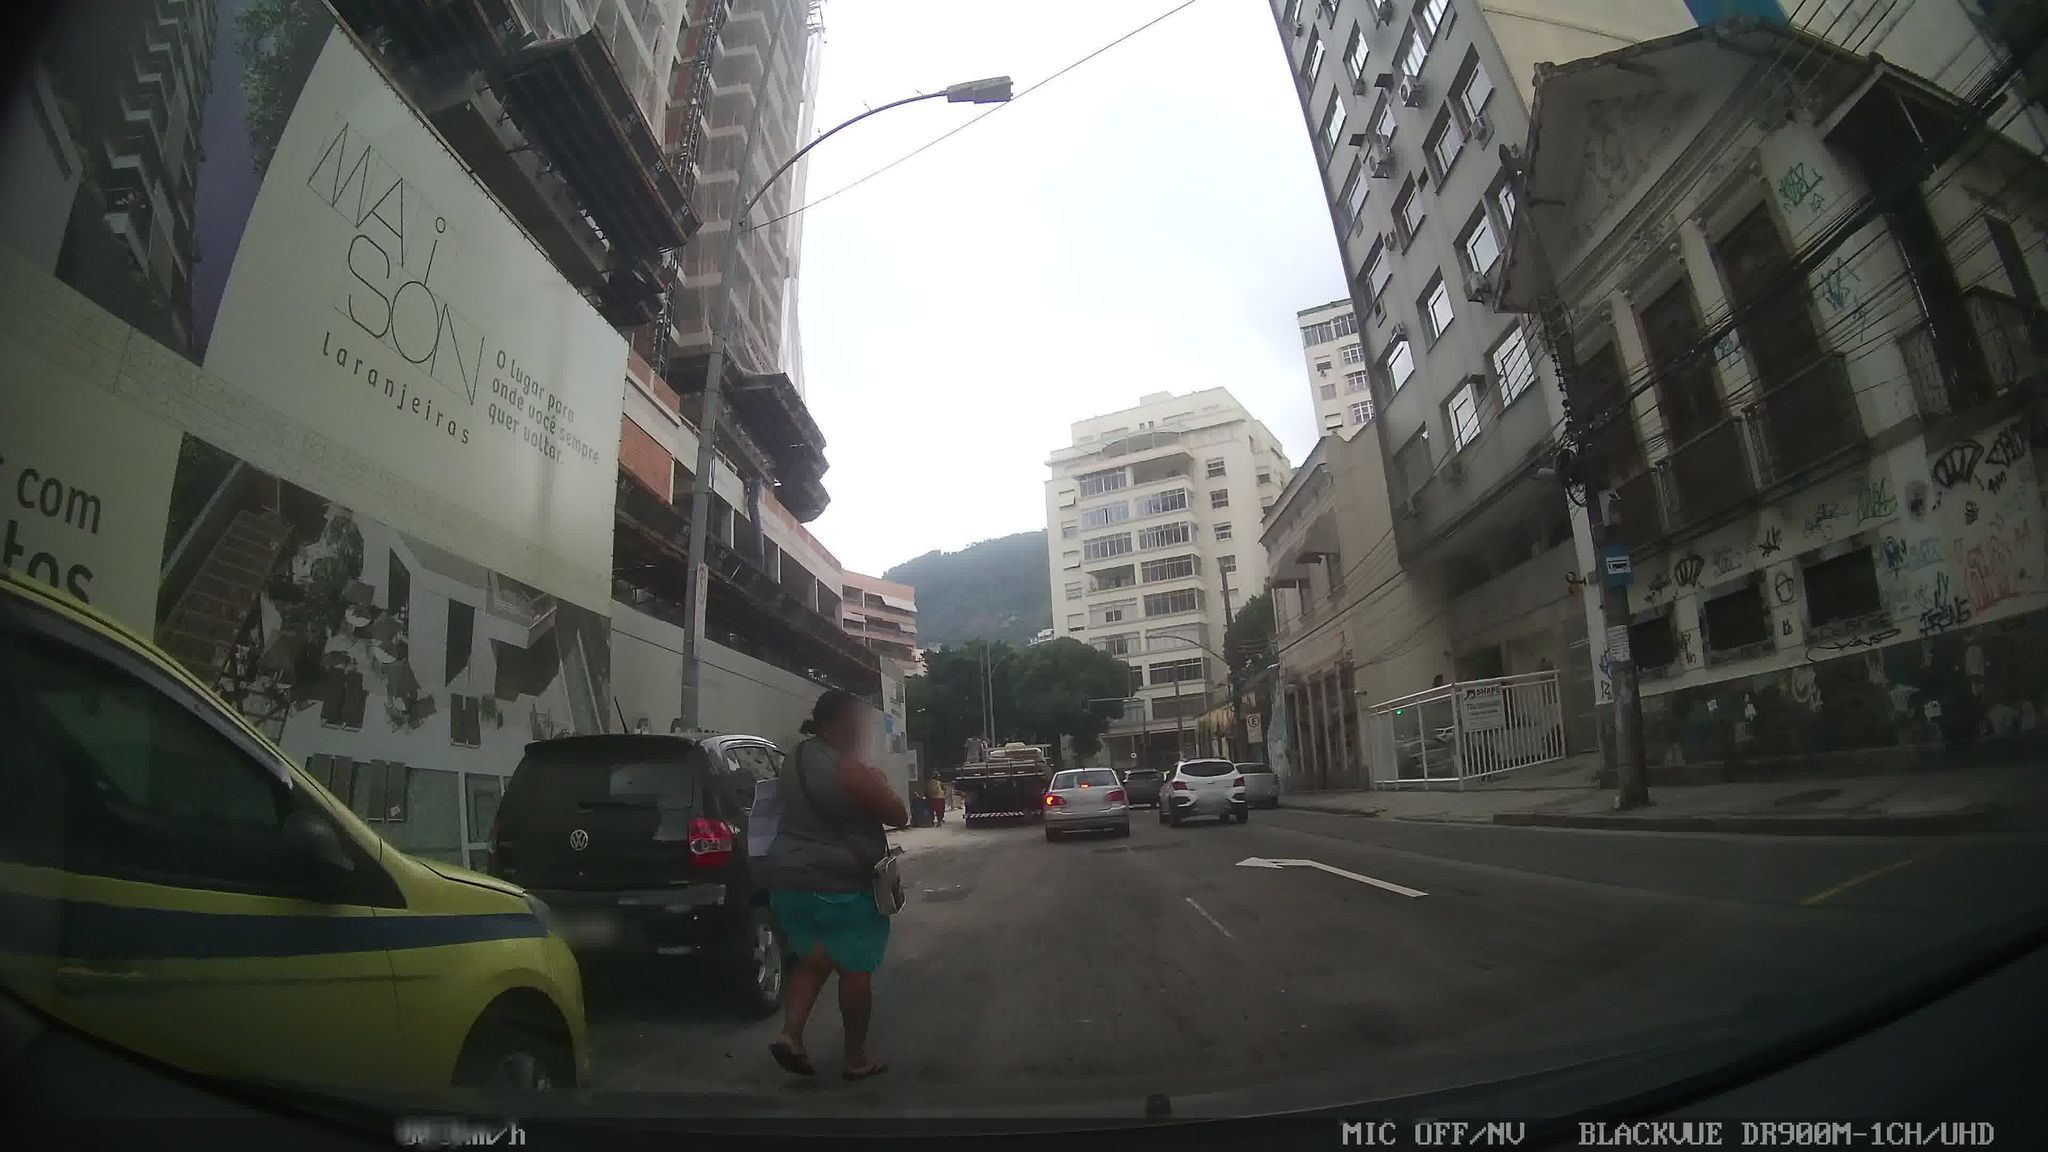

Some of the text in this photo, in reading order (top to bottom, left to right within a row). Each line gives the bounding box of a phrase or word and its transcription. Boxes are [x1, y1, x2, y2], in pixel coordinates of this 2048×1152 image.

[492, 377, 600, 465] onde você sempre
[496, 349, 575, 424] O lugar para
[488, 403, 564, 464] quer voltar.
[17, 467, 101, 534] com
